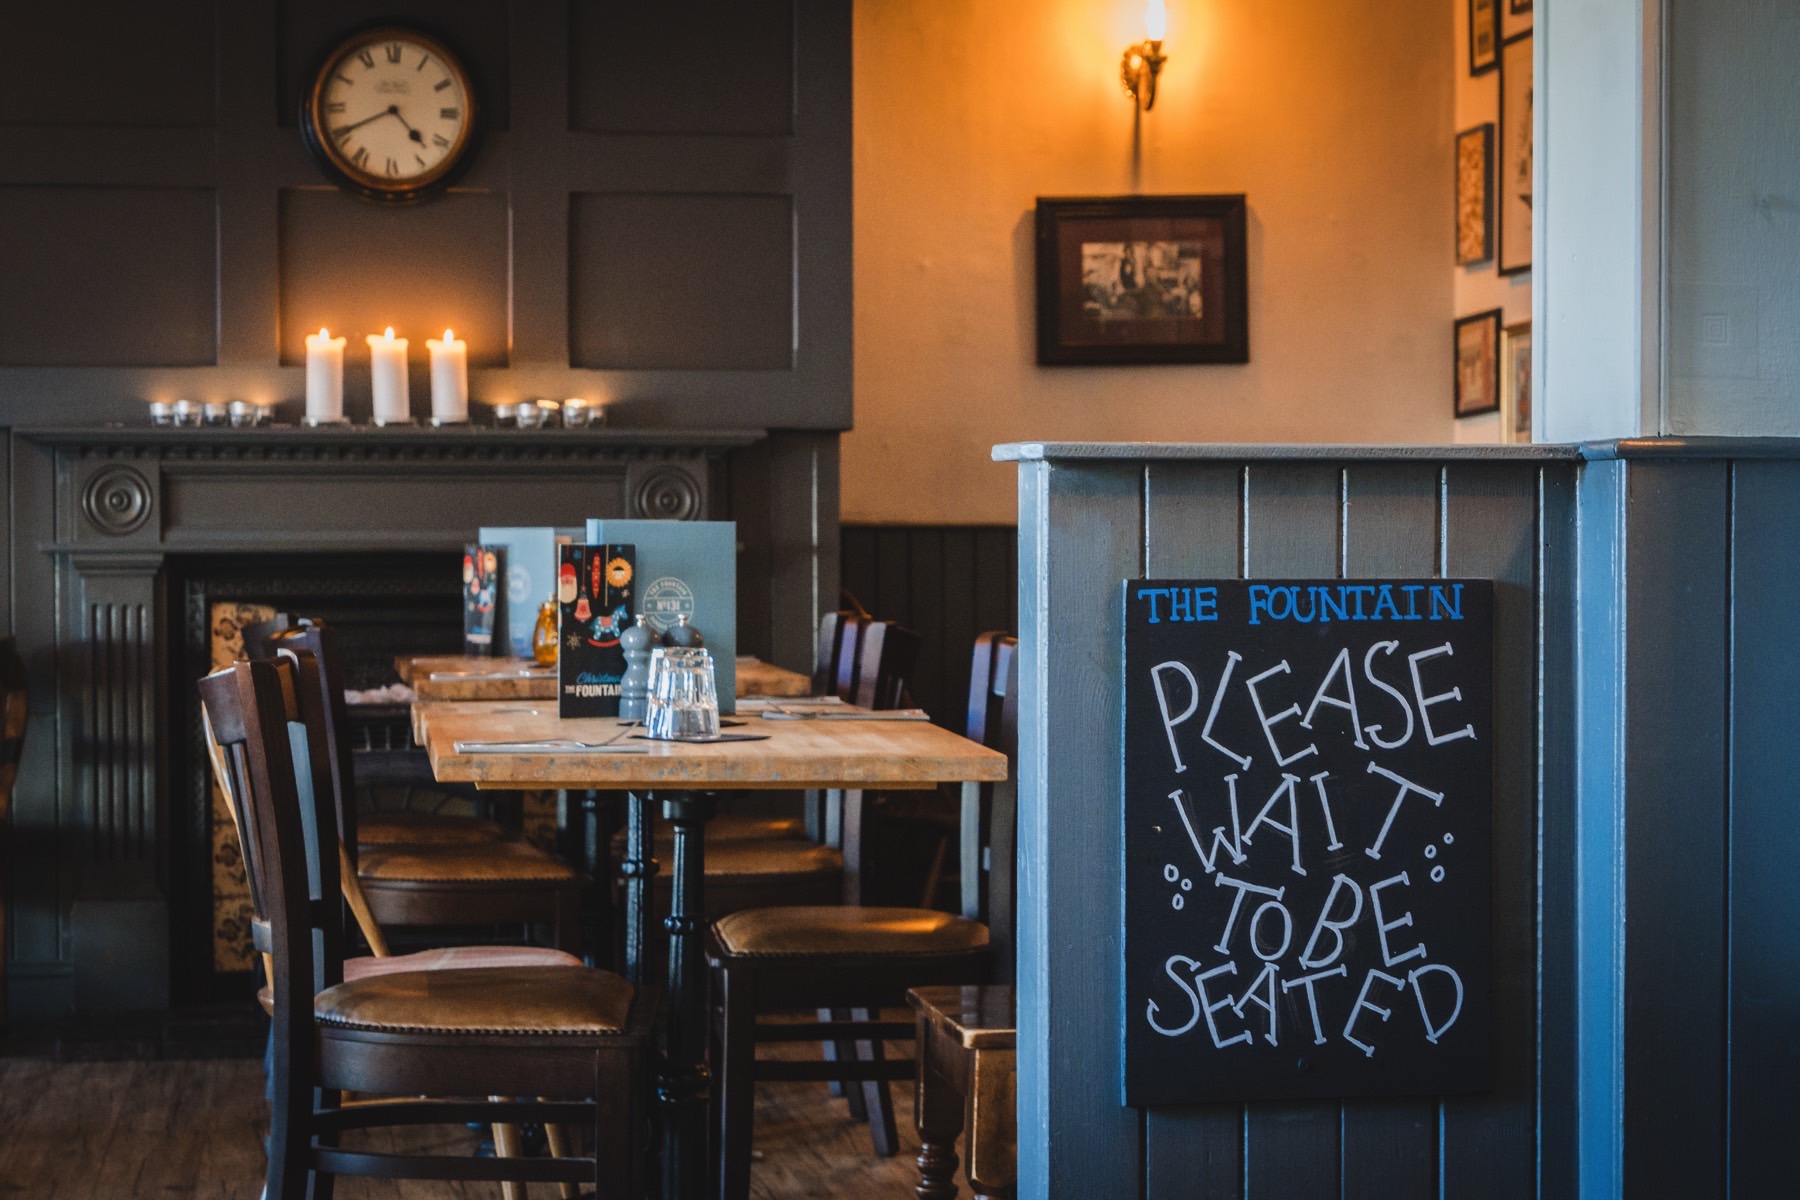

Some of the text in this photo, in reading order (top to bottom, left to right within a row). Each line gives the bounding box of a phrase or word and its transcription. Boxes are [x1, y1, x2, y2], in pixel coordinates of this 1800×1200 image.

[1137, 584, 1465, 624] THE FOUNTAIN
[1151, 639, 1476, 774] PLEASE
[1168, 761, 1445, 876] WAIT
[1213, 871, 1427, 969] TO BE
[1147, 955, 1464, 1057] SEATED
